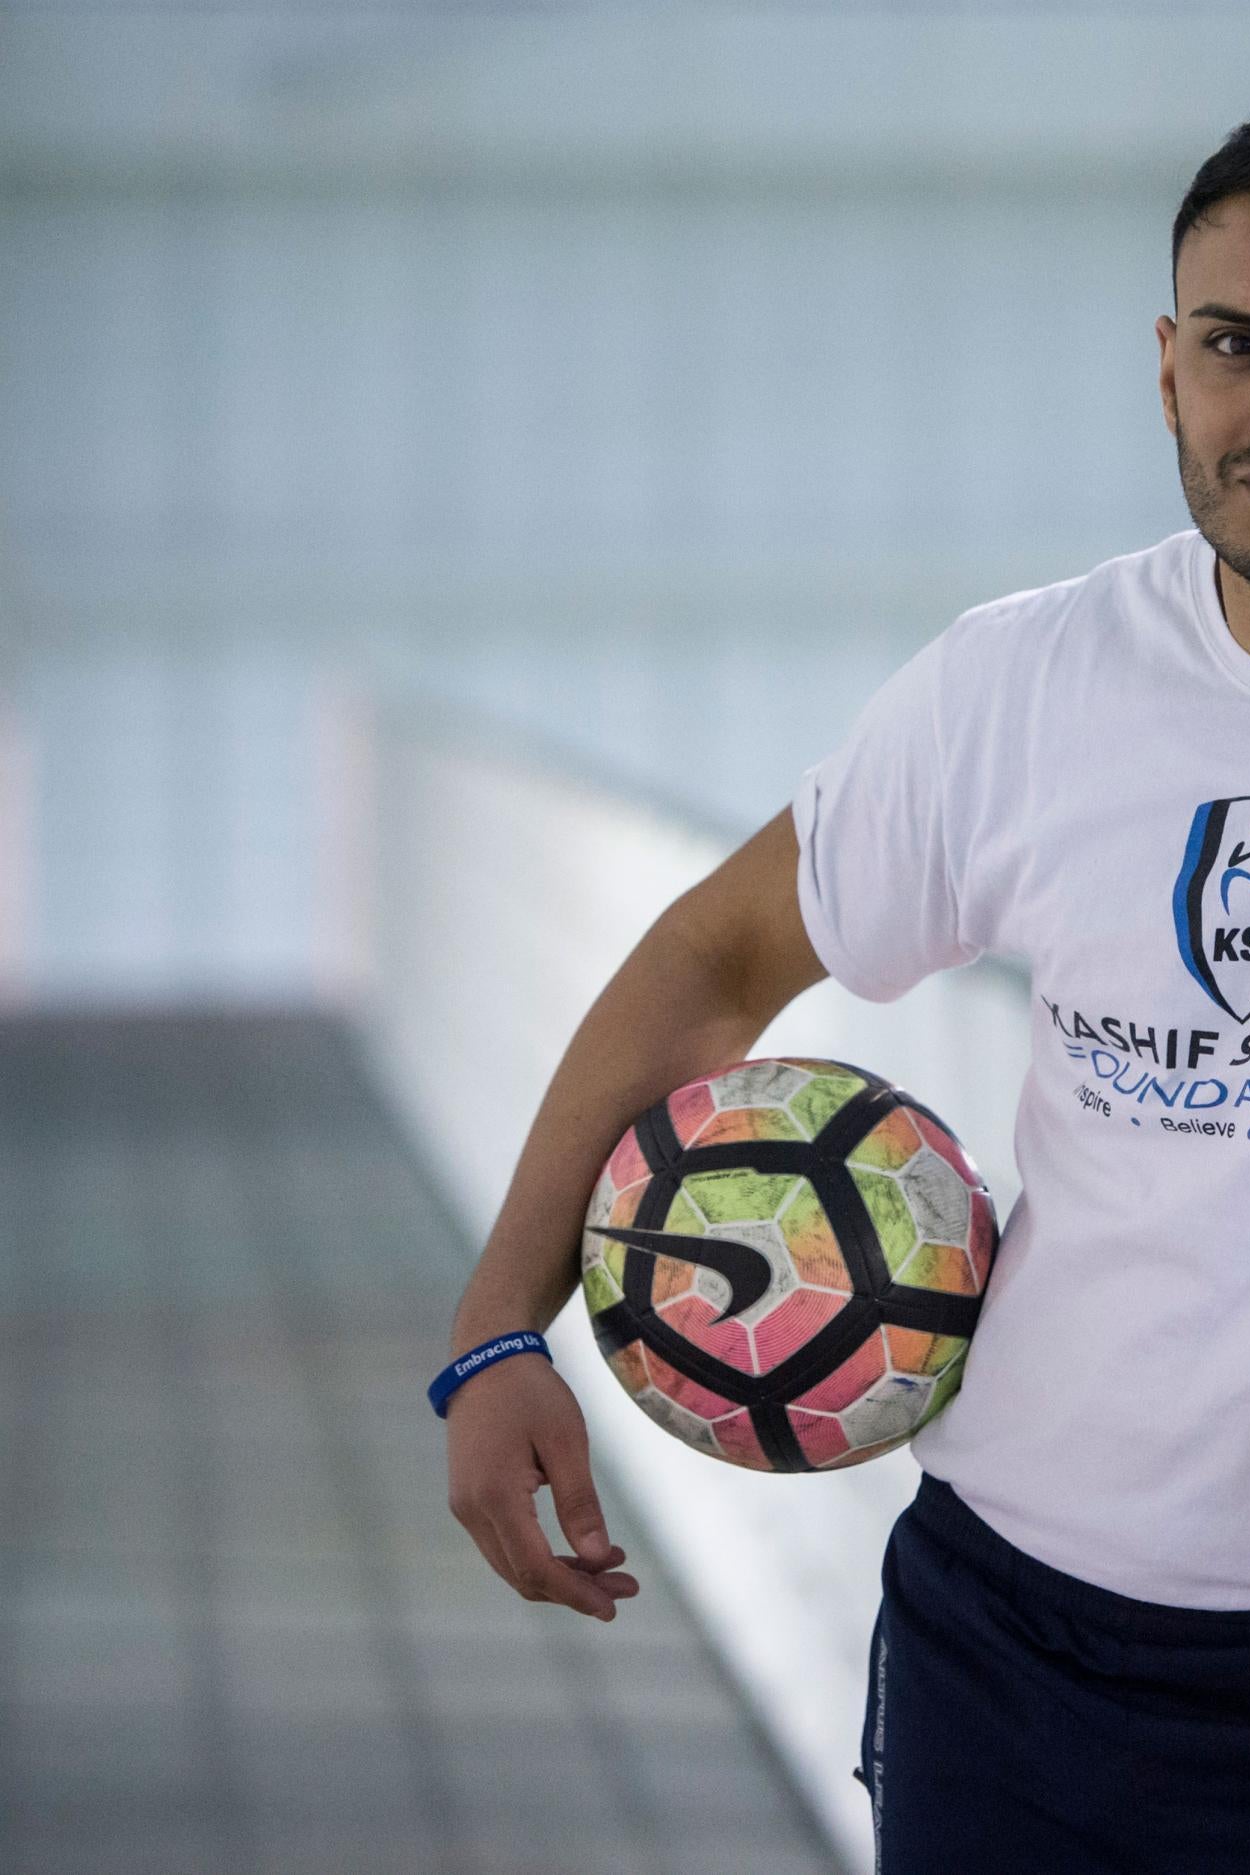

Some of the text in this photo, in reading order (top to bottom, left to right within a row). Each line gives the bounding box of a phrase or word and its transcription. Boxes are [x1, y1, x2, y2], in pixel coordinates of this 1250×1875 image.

[1073, 1084, 1112, 1118] spire
[1160, 1117, 1236, 1139] Believe
[454, 1338, 524, 1376] Embracing
